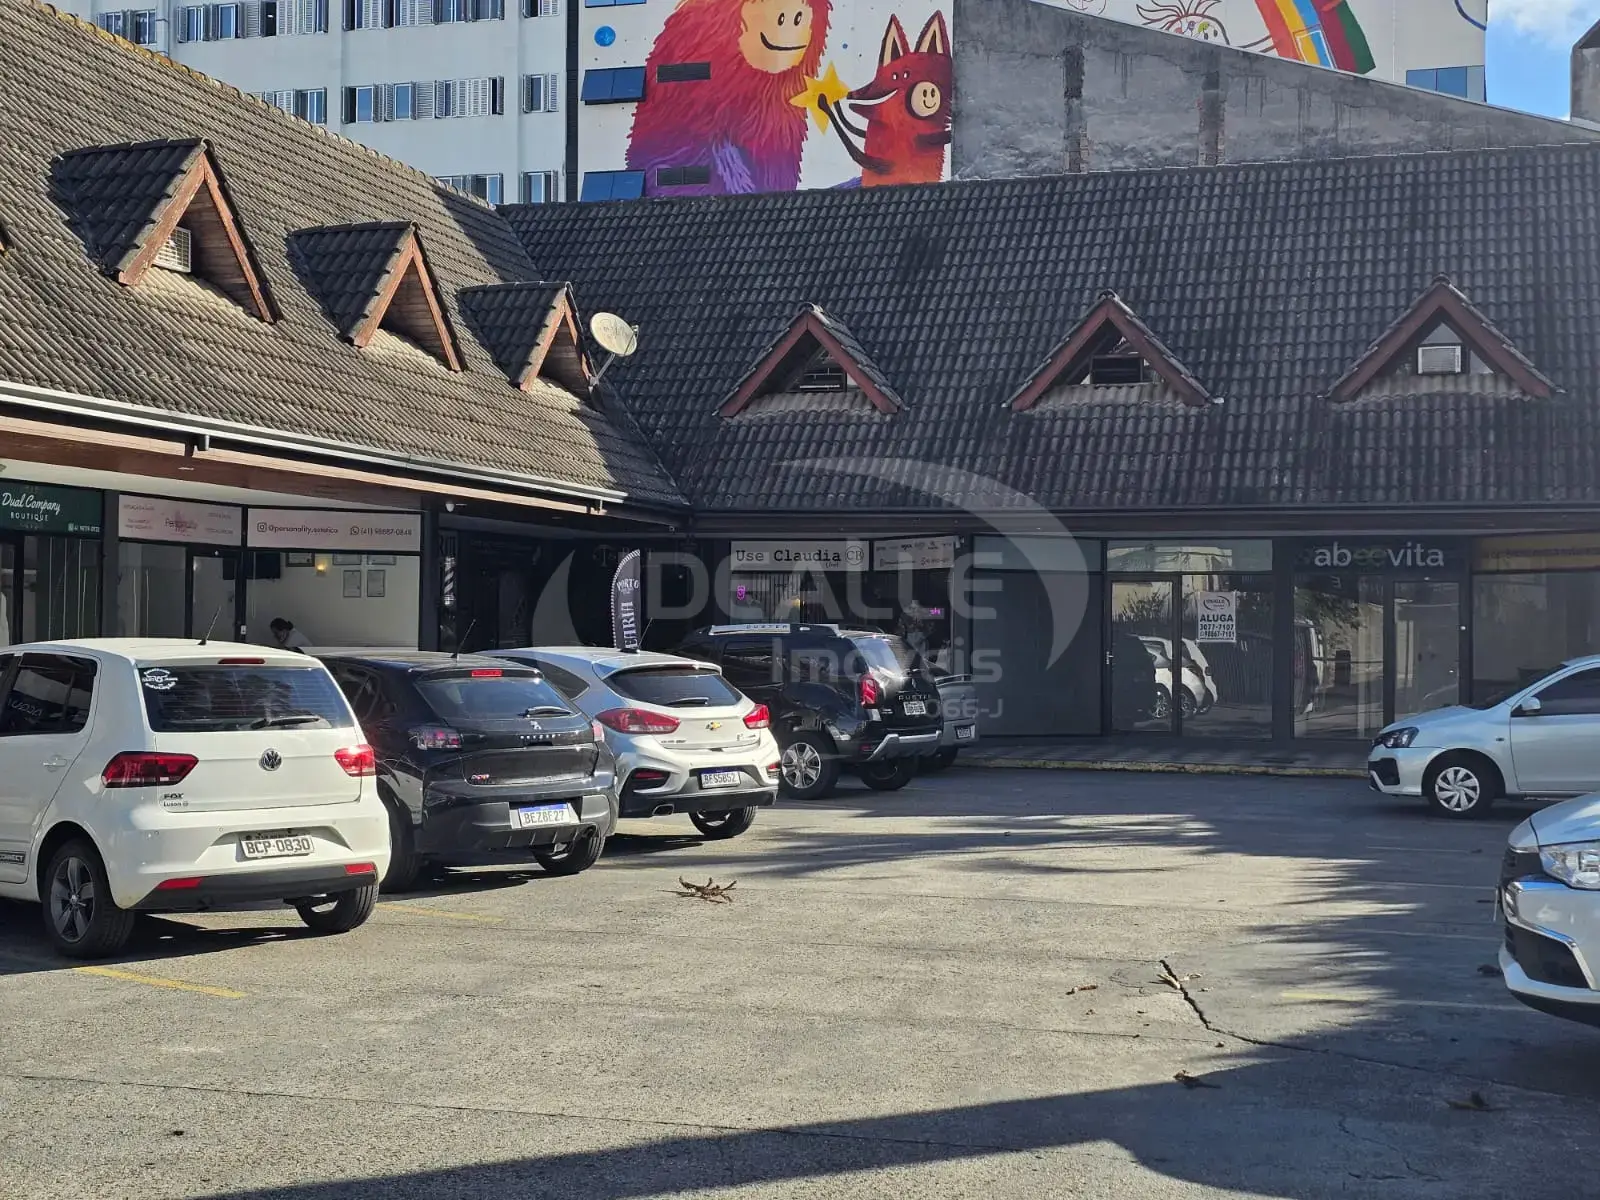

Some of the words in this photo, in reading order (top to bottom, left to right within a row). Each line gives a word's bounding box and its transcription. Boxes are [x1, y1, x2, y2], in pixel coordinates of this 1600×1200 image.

[2, 492, 26, 508] Dual
[25, 494, 60, 515] Company
[10, 511, 49, 522] BOUTIQUE
[735, 550, 764, 562] Use
[773, 549, 841, 562] Claudia
[1199, 614, 1234, 622] ALUGA
[163, 792, 184, 800] FOX
[245, 838, 311, 854] BCP-0830
